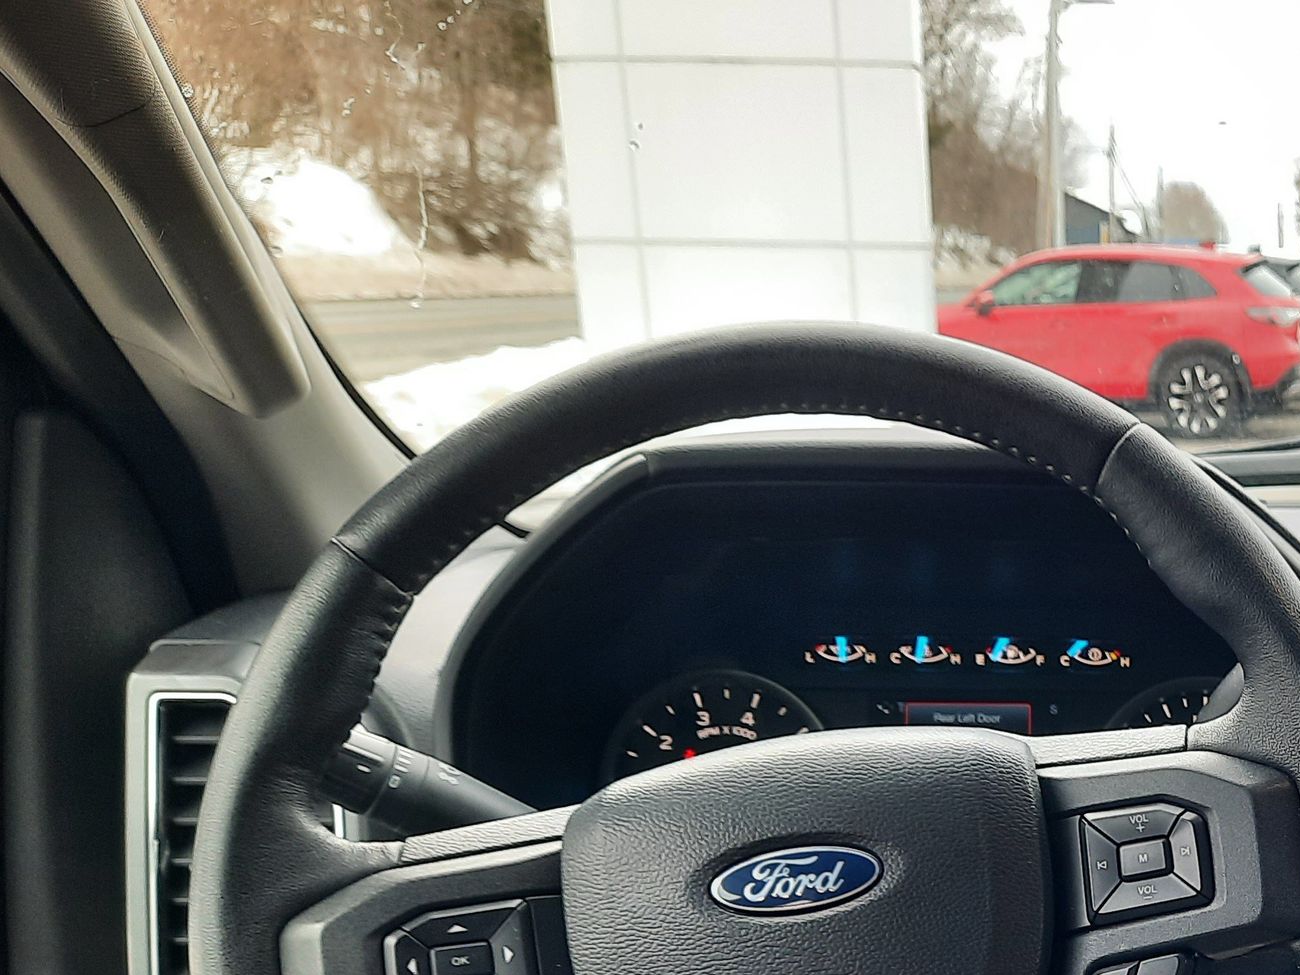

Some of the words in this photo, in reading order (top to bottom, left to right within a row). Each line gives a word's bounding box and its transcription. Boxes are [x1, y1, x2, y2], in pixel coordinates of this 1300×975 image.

[696, 710, 711, 727] 3
[740, 711, 755, 727] 4
[957, 712, 975, 723] Left
[976, 712, 1001, 723] Door
[658, 735, 674, 751] 2
[1129, 814, 1149, 825] VOL
[1138, 853, 1149, 864] M
[743, 855, 846, 903] Ford
[1137, 885, 1158, 896] VOL
[451, 955, 470, 967] OK
